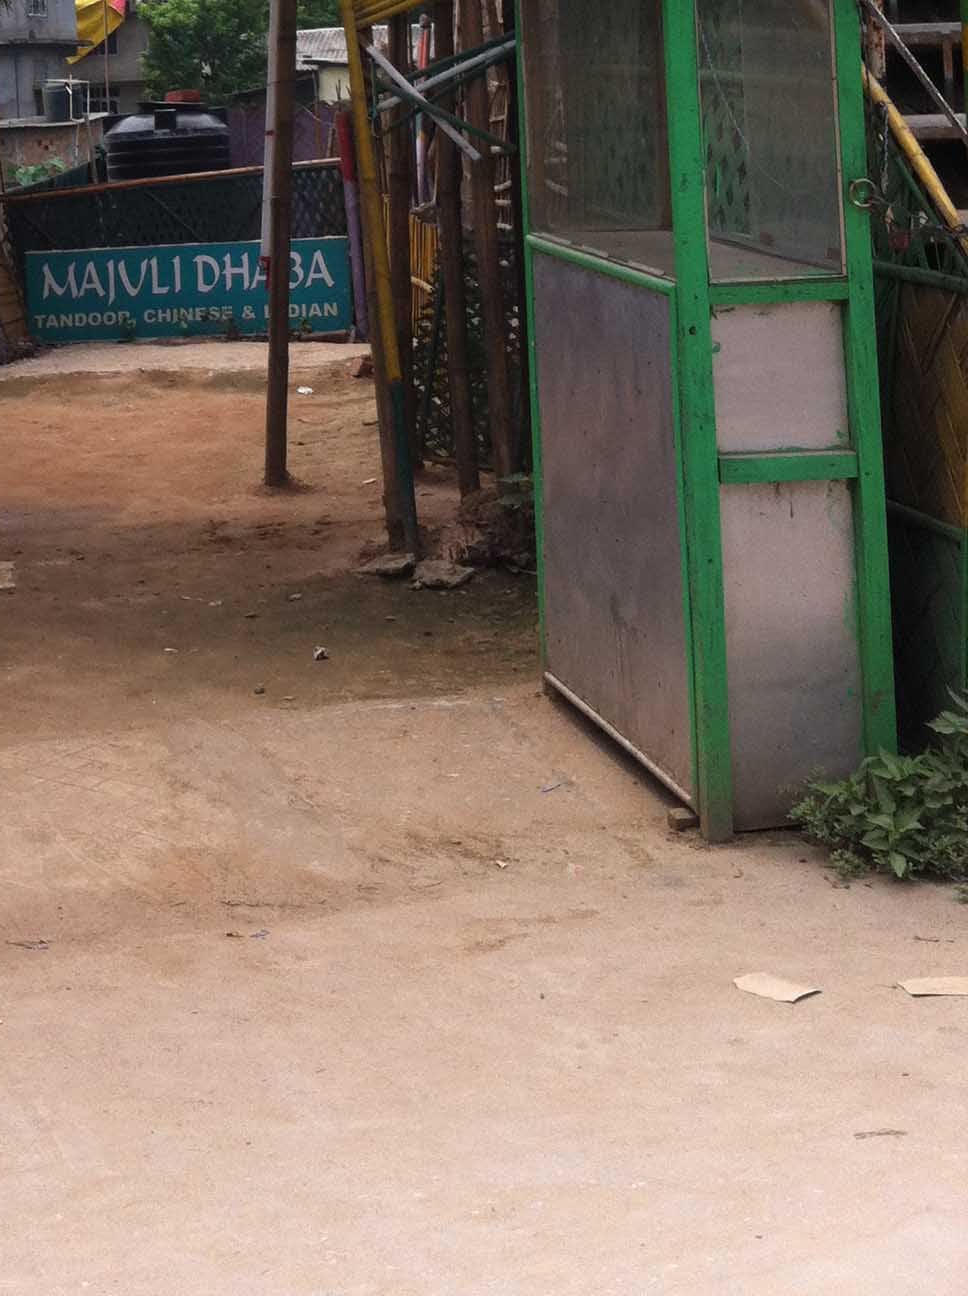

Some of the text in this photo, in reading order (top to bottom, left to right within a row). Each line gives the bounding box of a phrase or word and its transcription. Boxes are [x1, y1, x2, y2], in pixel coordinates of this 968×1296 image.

[42, 253, 183, 306] MAJULI
[143, 304, 233, 325] CHINESE
[241, 305, 257, 321] &
[264, 302, 340, 320] IDIAN
